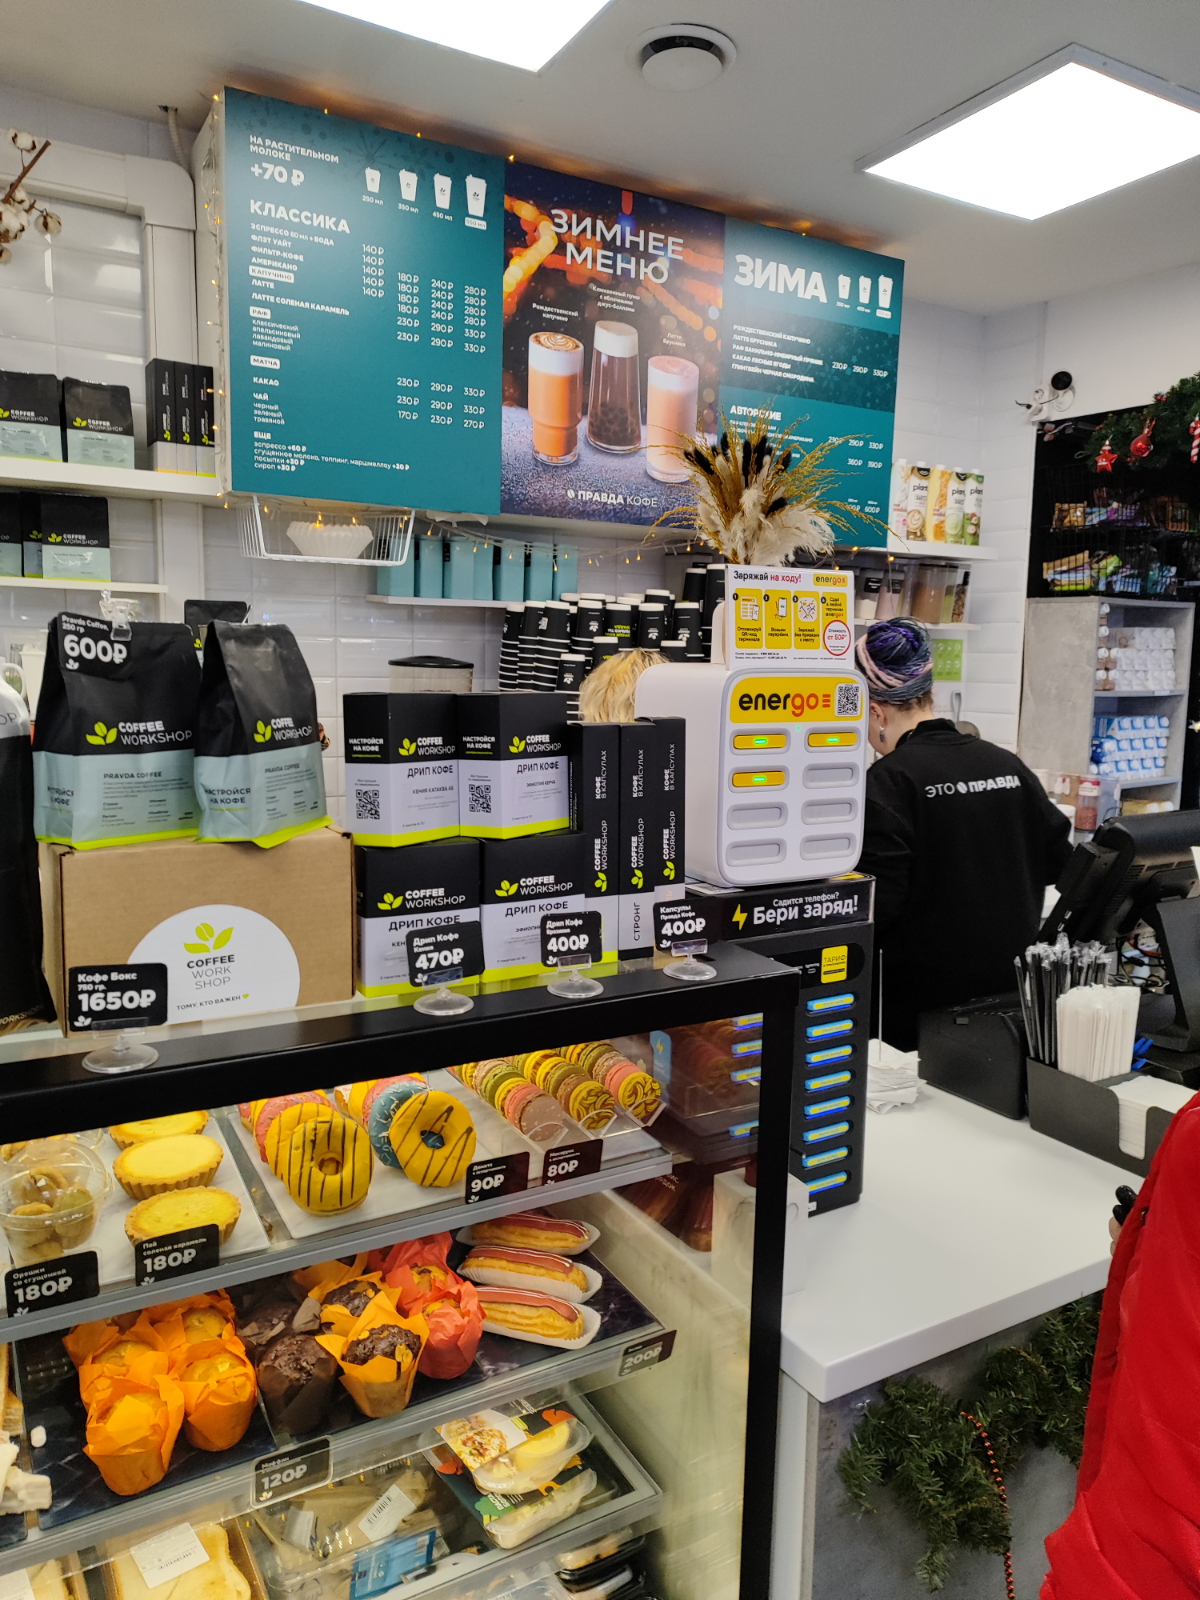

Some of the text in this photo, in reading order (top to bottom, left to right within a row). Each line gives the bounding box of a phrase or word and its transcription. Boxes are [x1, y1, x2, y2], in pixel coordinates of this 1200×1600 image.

[250, 135, 339, 164] НА РАСТИТЕЛЬНОМ
[250, 145, 291, 161] МОЛОКЕ
[250, 200, 350, 234] КЛАССИКА
[251, 223, 334, 246] ЭСПРЕССО ВОДА
[551, 209, 684, 260] ЗИМНЕЕ
[272, 238, 292, 248] УАЙТ
[252, 256, 298, 271] АМЕРИКАНО
[566, 243, 668, 284] МЕНЮ
[252, 279, 275, 289] ЛАТТЕ
[734, 254, 828, 304] ЗИМА
[252, 292, 350, 316] ЛАТТЕ СОЛЕНАЯ КАРАМЕЛЬ
[532, 303, 578, 317] Рождественский
[252, 358, 278, 367] МАТЧА
[253, 376, 279, 387] КАКАО
[254, 392, 269, 402] ЧАЙ
[578, 490, 658, 508] ПРАВДА КОФЕ
[734, 571, 768, 582] Заряжай
[781, 574, 802, 584] ходу!
[62, 614, 85, 626] Pravda
[62, 624, 75, 632] 250
[63, 634, 128, 664] 600₽
[118, 720, 164, 732] COFFEE
[120, 730, 192, 746] WORKSHOP
[273, 726, 312, 741] WORKSHOP
[526, 734, 550, 744] COFFEE
[417, 736, 443, 746] COFFEE
[526, 743, 562, 752] WORKSHOP
[418, 746, 456, 756] WORKSHOP
[264, 766, 284, 774] PRAVDA
[408, 764, 454, 778] ДРИП КОФЕ
[517, 760, 560, 774] ДРИП КОФЕ
[924, 775, 1020, 798] ЭТО ПРАВДА
[220, 796, 246, 804] КОФЕ
[520, 876, 554, 886] COFFEE
[405, 888, 444, 898] COFFEE
[520, 882, 573, 895] WORKSHOP
[405, 895, 466, 908] WORKSHOP
[773, 892, 840, 908] Садится телефон?
[506, 901, 568, 917] ДРИП КОФЕ
[660, 905, 691, 914] Капсулы
[660, 910, 696, 921] Правда Кофе
[754, 895, 858, 924] Бери заряд!
[388, 915, 460, 932] ДРИП КОФЕ
[546, 918, 582, 929] Дрип Кофе
[661, 918, 706, 936] 400₽
[412, 932, 460, 946] Дрип Кофе
[547, 934, 589, 952] 400₽
[187, 954, 235, 969] COFFEE
[415, 948, 464, 970] 470₽
[824, 954, 846, 964] ТАРИФ
[78, 972, 138, 984] Кофе Бокс
[192, 966, 232, 979] WORK
[194, 976, 230, 990] SHOP
[78, 989, 156, 1012] 1650₽
[214, 995, 241, 1004] ВАЖЕН
[547, 1160, 578, 1177] 80₽
[471, 1174, 504, 1193] 90₽
[142, 1241, 158, 1250] Пай
[142, 1237, 207, 1256] соленая карамель
[143, 1248, 196, 1272] 180₽
[12, 1267, 46, 1280] Орешки
[24, 1268, 66, 1284] сгущенкой
[14, 1276, 72, 1304] 180₽
[624, 1346, 662, 1368] 200₽
[262, 1464, 308, 1490] 120₽
